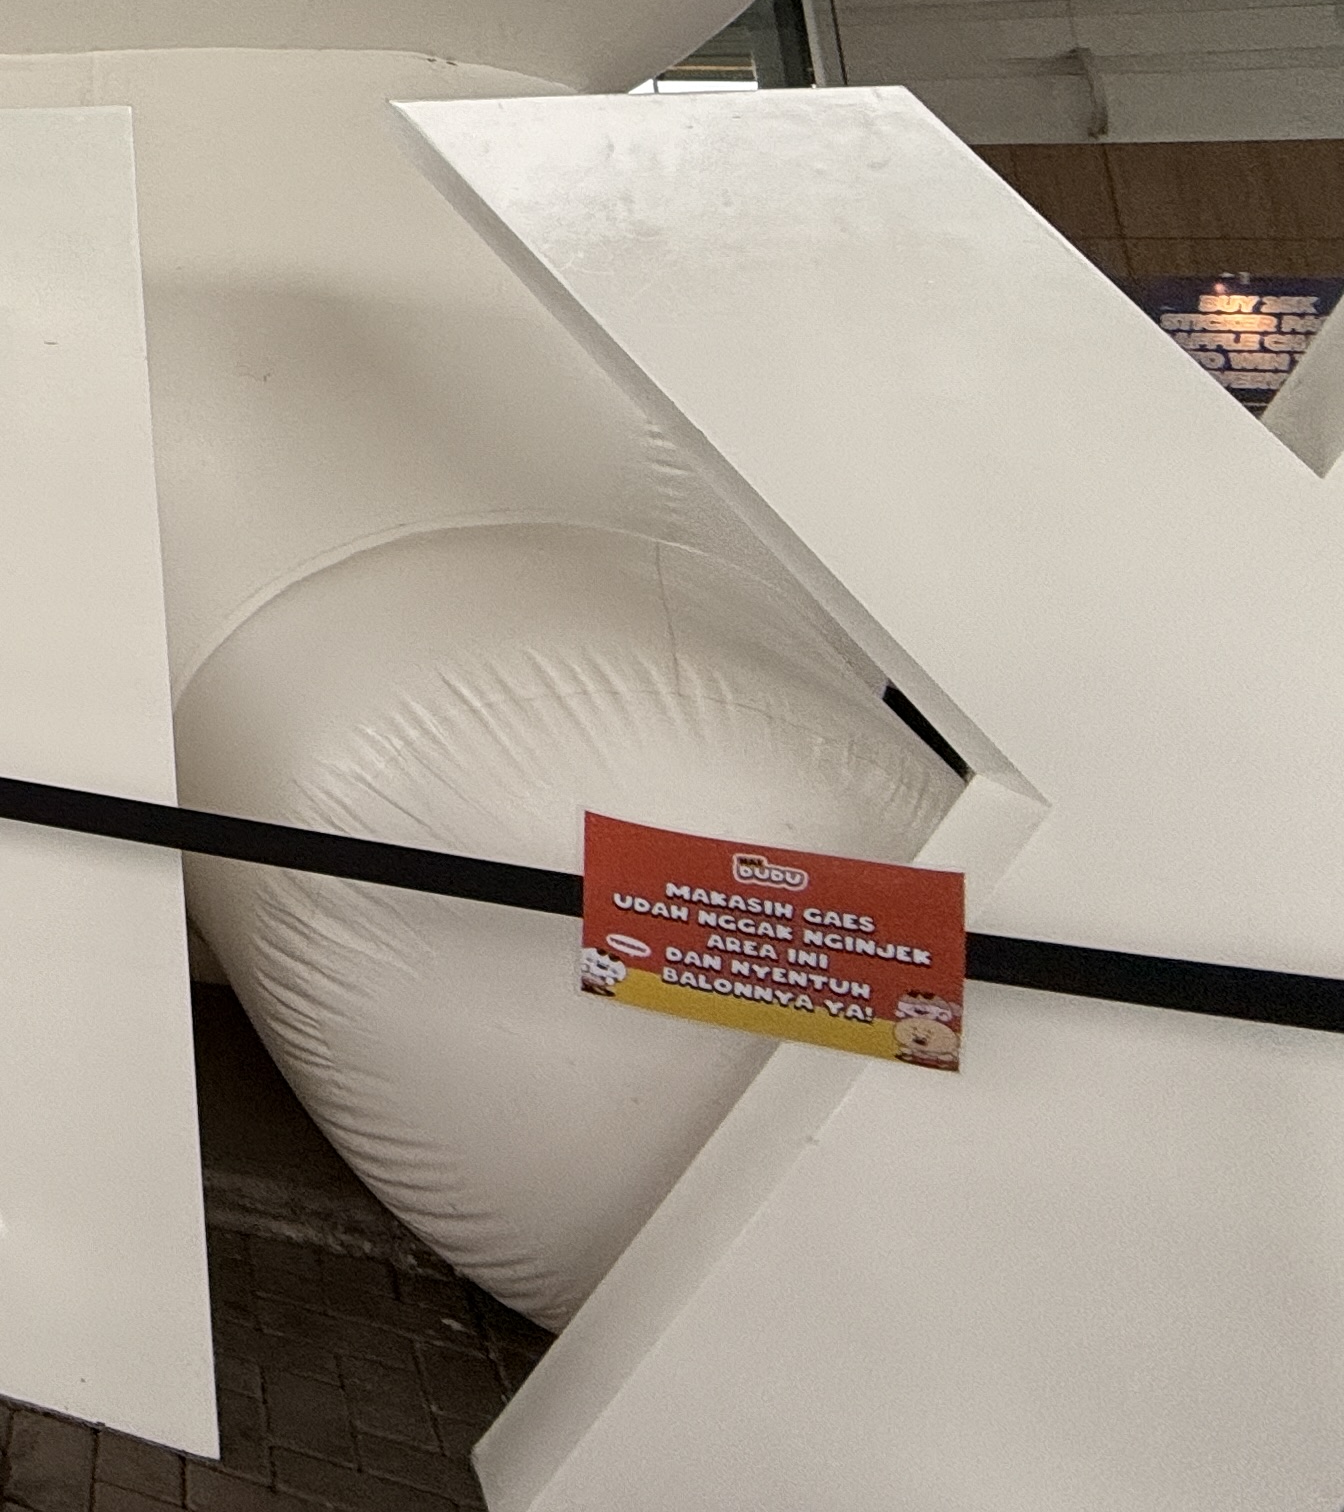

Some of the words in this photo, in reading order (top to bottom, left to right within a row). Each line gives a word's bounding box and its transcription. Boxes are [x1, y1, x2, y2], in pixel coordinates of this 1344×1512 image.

[738, 863, 804, 886] DUDU
[612, 892, 689, 922] UDAH
[697, 908, 794, 942] NGGAK
[802, 929, 933, 967] NGINJEK
[665, 881, 794, 919] MAKASIH
[802, 907, 876, 934] GAES
[664, 945, 722, 972] DAN
[730, 959, 872, 1000] NYENTUH
[706, 934, 779, 961] AREA
[787, 950, 830, 970] INI
[660, 966, 815, 1013] BALONNYA
[823, 997, 875, 1024] YA!
